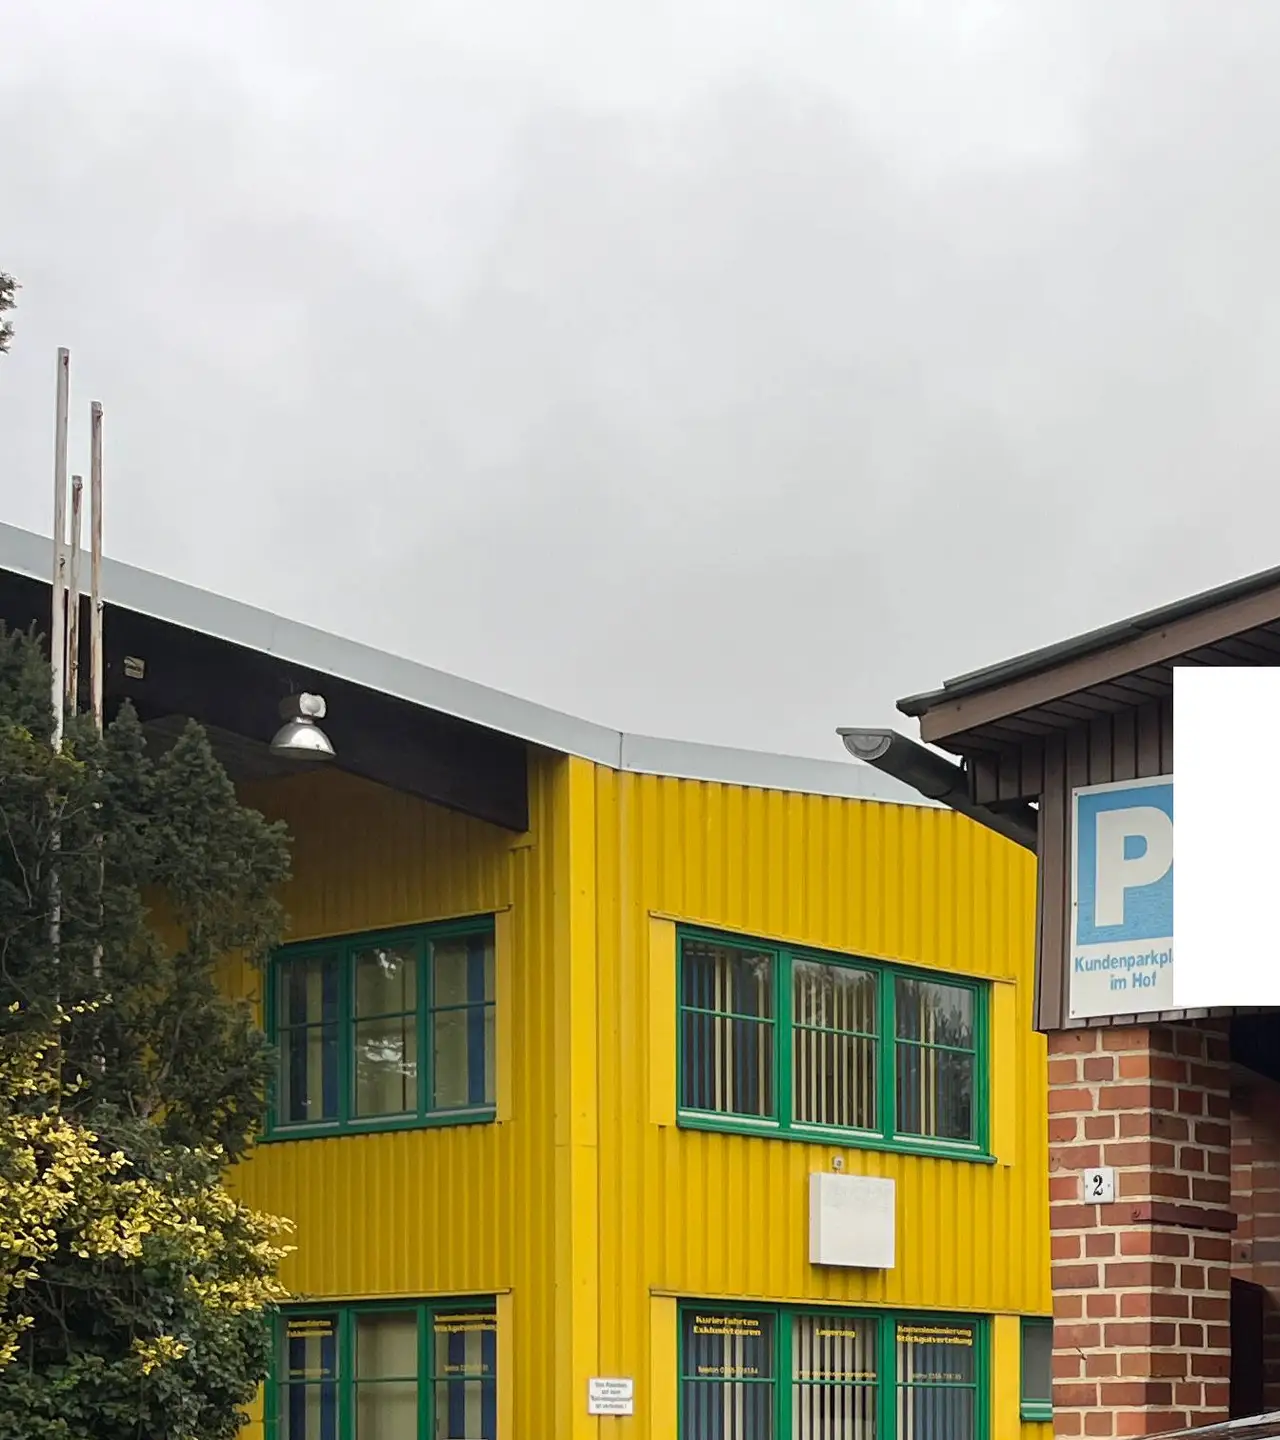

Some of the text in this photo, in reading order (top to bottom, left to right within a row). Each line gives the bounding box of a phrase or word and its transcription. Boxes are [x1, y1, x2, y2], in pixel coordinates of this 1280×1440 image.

[1094, 806, 1173, 927] P
[1075, 948, 1173, 972] Kundenparkpl
[1110, 971, 1156, 990] im Hof
[1093, 1175, 1104, 1197] 2
